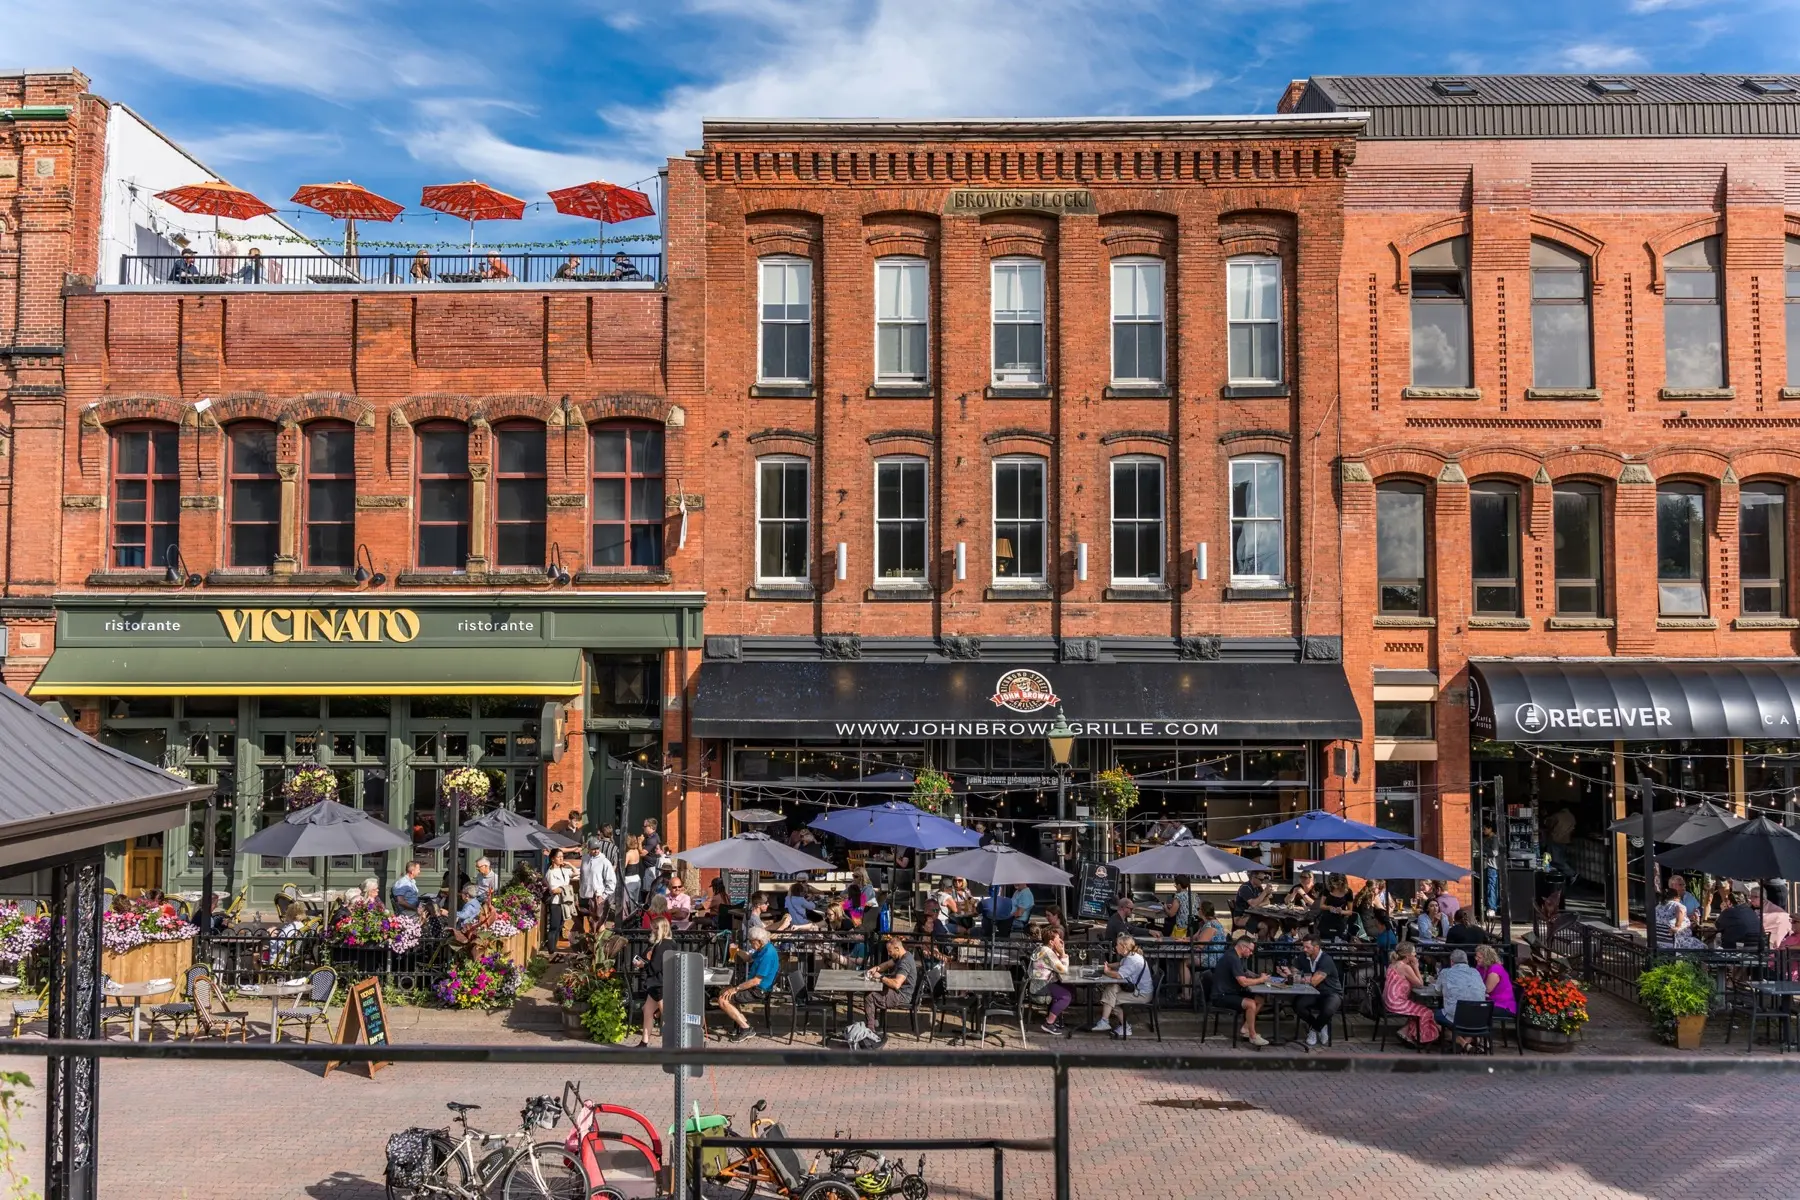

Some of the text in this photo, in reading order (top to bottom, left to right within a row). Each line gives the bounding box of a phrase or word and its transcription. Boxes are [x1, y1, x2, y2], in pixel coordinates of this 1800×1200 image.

[955, 192, 1086, 208] BROWN'S BLOCK
[105, 619, 181, 631] ristorante
[216, 608, 421, 643] VICINATO
[458, 619, 534, 631] ristorante
[1030, 673, 1048, 693] STREET
[1000, 691, 1050, 701] JOHN BROWN
[1549, 708, 1673, 728] RECEIVER
[835, 723, 1218, 736] WWW.JOHNBROWGRILLE.COM
